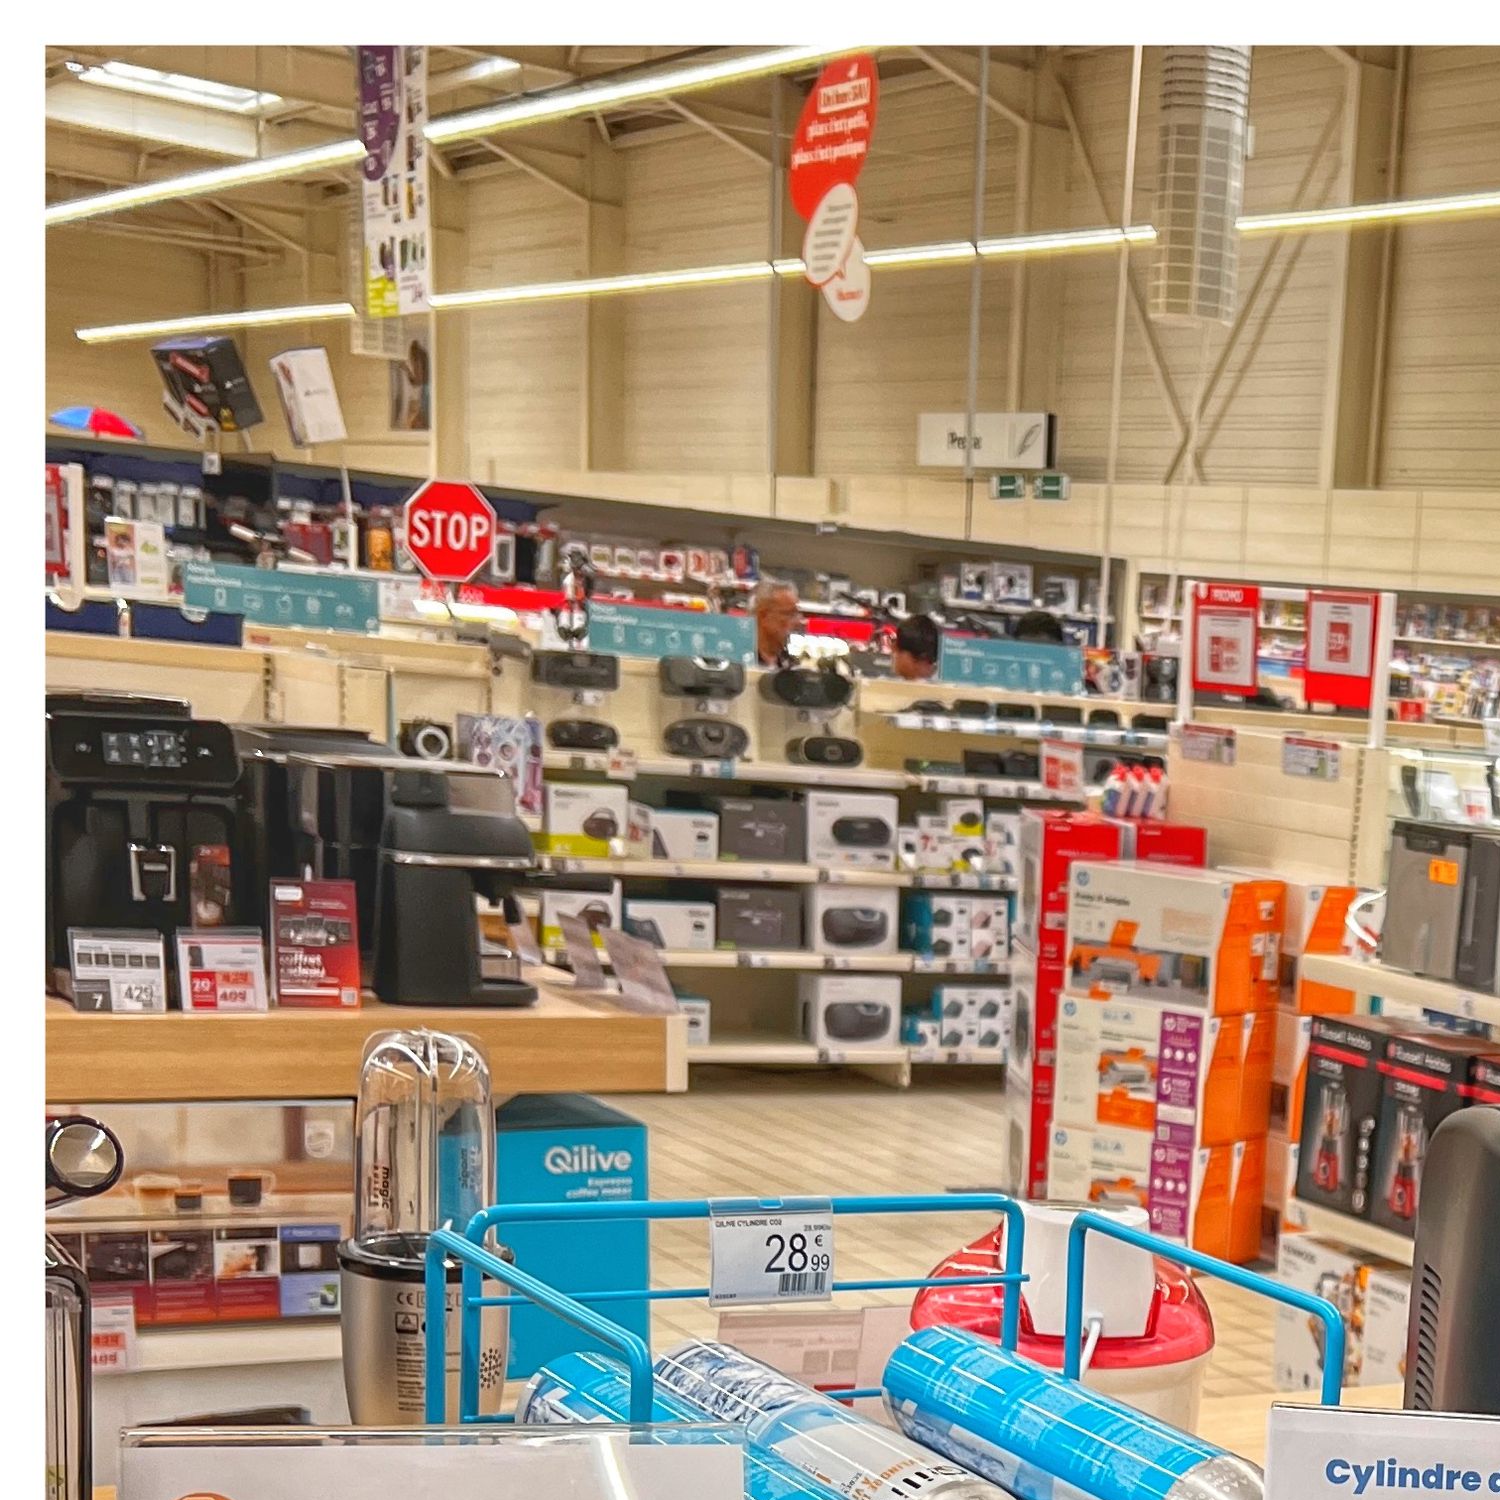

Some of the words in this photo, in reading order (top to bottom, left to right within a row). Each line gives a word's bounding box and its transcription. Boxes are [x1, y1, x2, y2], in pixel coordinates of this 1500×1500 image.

[411, 509, 488, 551] STOP
[544, 1144, 632, 1175] Qilive
[737, 1218, 768, 1227] CYLINDRE
[765, 1233, 808, 1273] 28
[815, 1234, 824, 1247] €
[811, 1254, 830, 1272] 99
[1325, 1458, 1481, 1494] Cylindre
